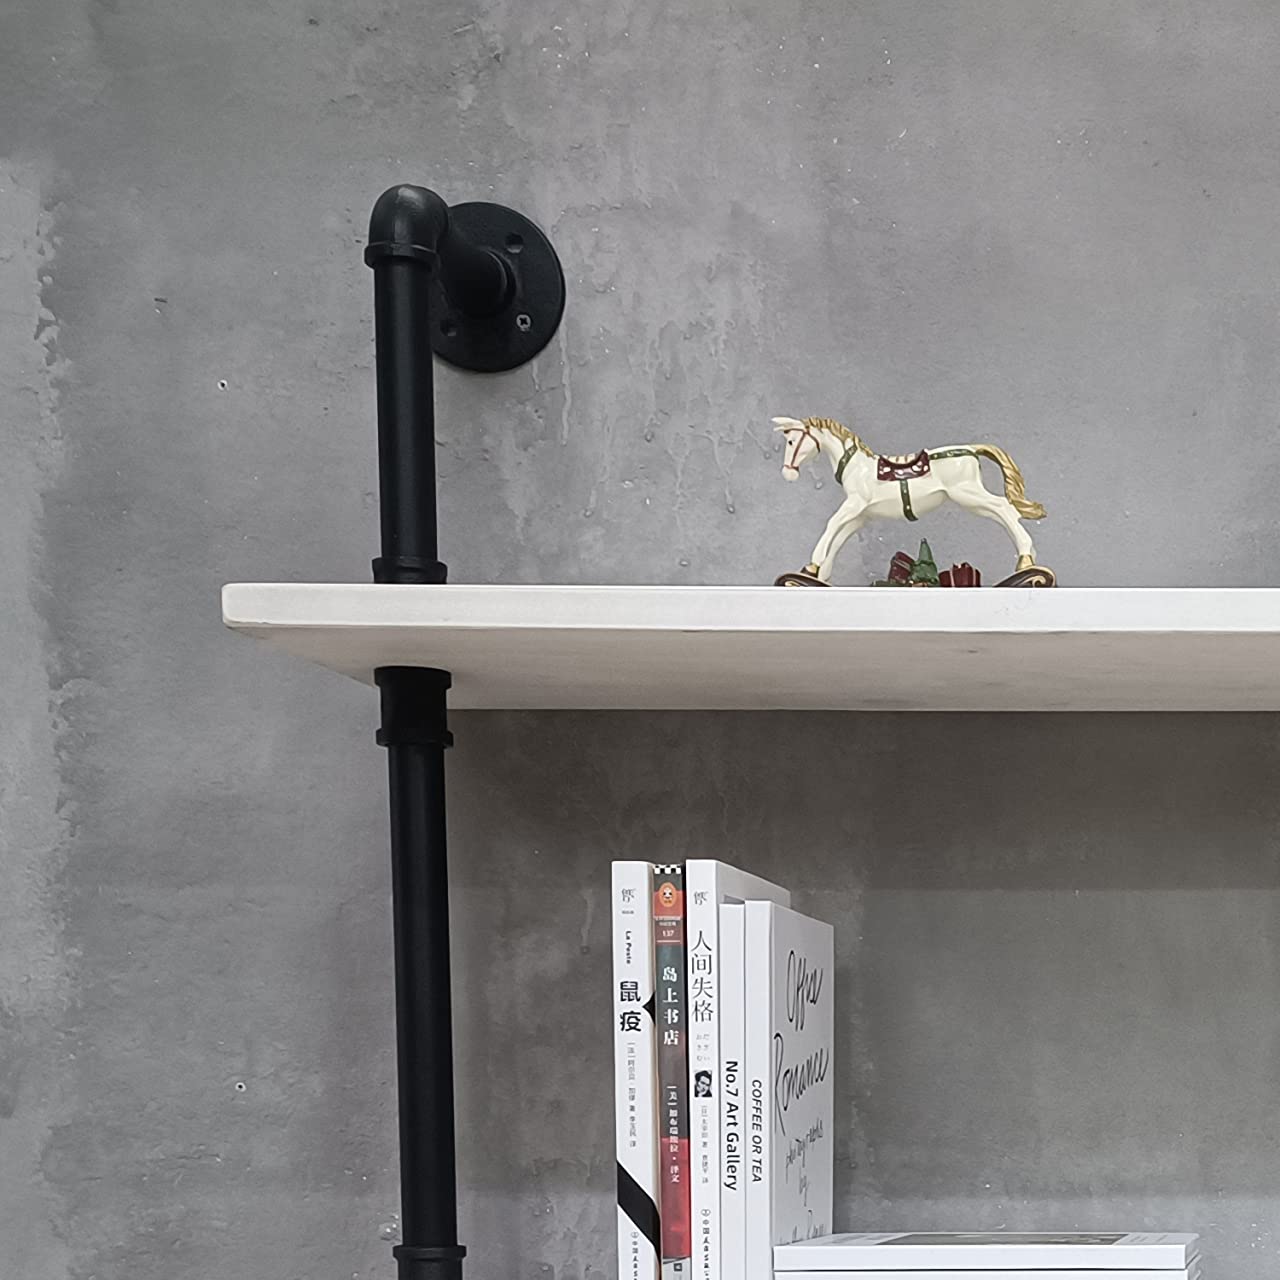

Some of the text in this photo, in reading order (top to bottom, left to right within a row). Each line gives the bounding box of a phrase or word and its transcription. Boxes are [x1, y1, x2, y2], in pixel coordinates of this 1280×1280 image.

[619, 979, 643, 1033] 鼠疫
[662, 965, 680, 1046] 岛上书店
[690, 929, 714, 1024] 人间失格
[723, 1060, 742, 1192] No.7 Art Gallery
[751, 1079, 763, 1183] COFFEE OR TEA
